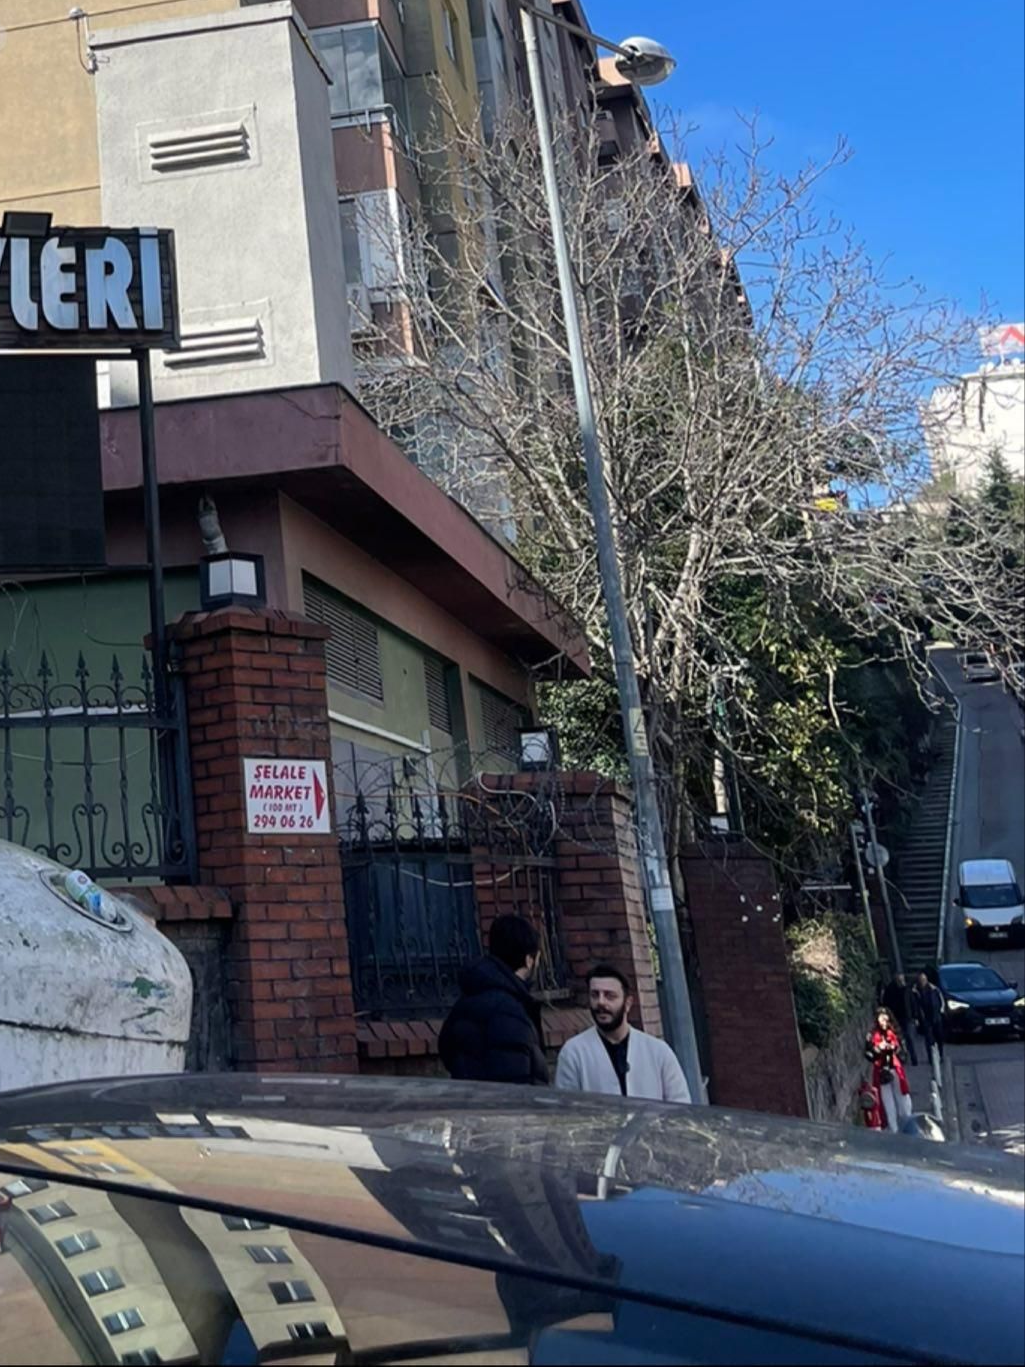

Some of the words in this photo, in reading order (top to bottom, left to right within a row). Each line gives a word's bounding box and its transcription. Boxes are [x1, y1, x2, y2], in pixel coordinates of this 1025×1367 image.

[254, 765, 306, 782] ŞELALE
[249, 785, 312, 800] MARKET
[254, 814, 276, 828] 294
[280, 815, 296, 828] 06
[299, 815, 313, 828] 26
